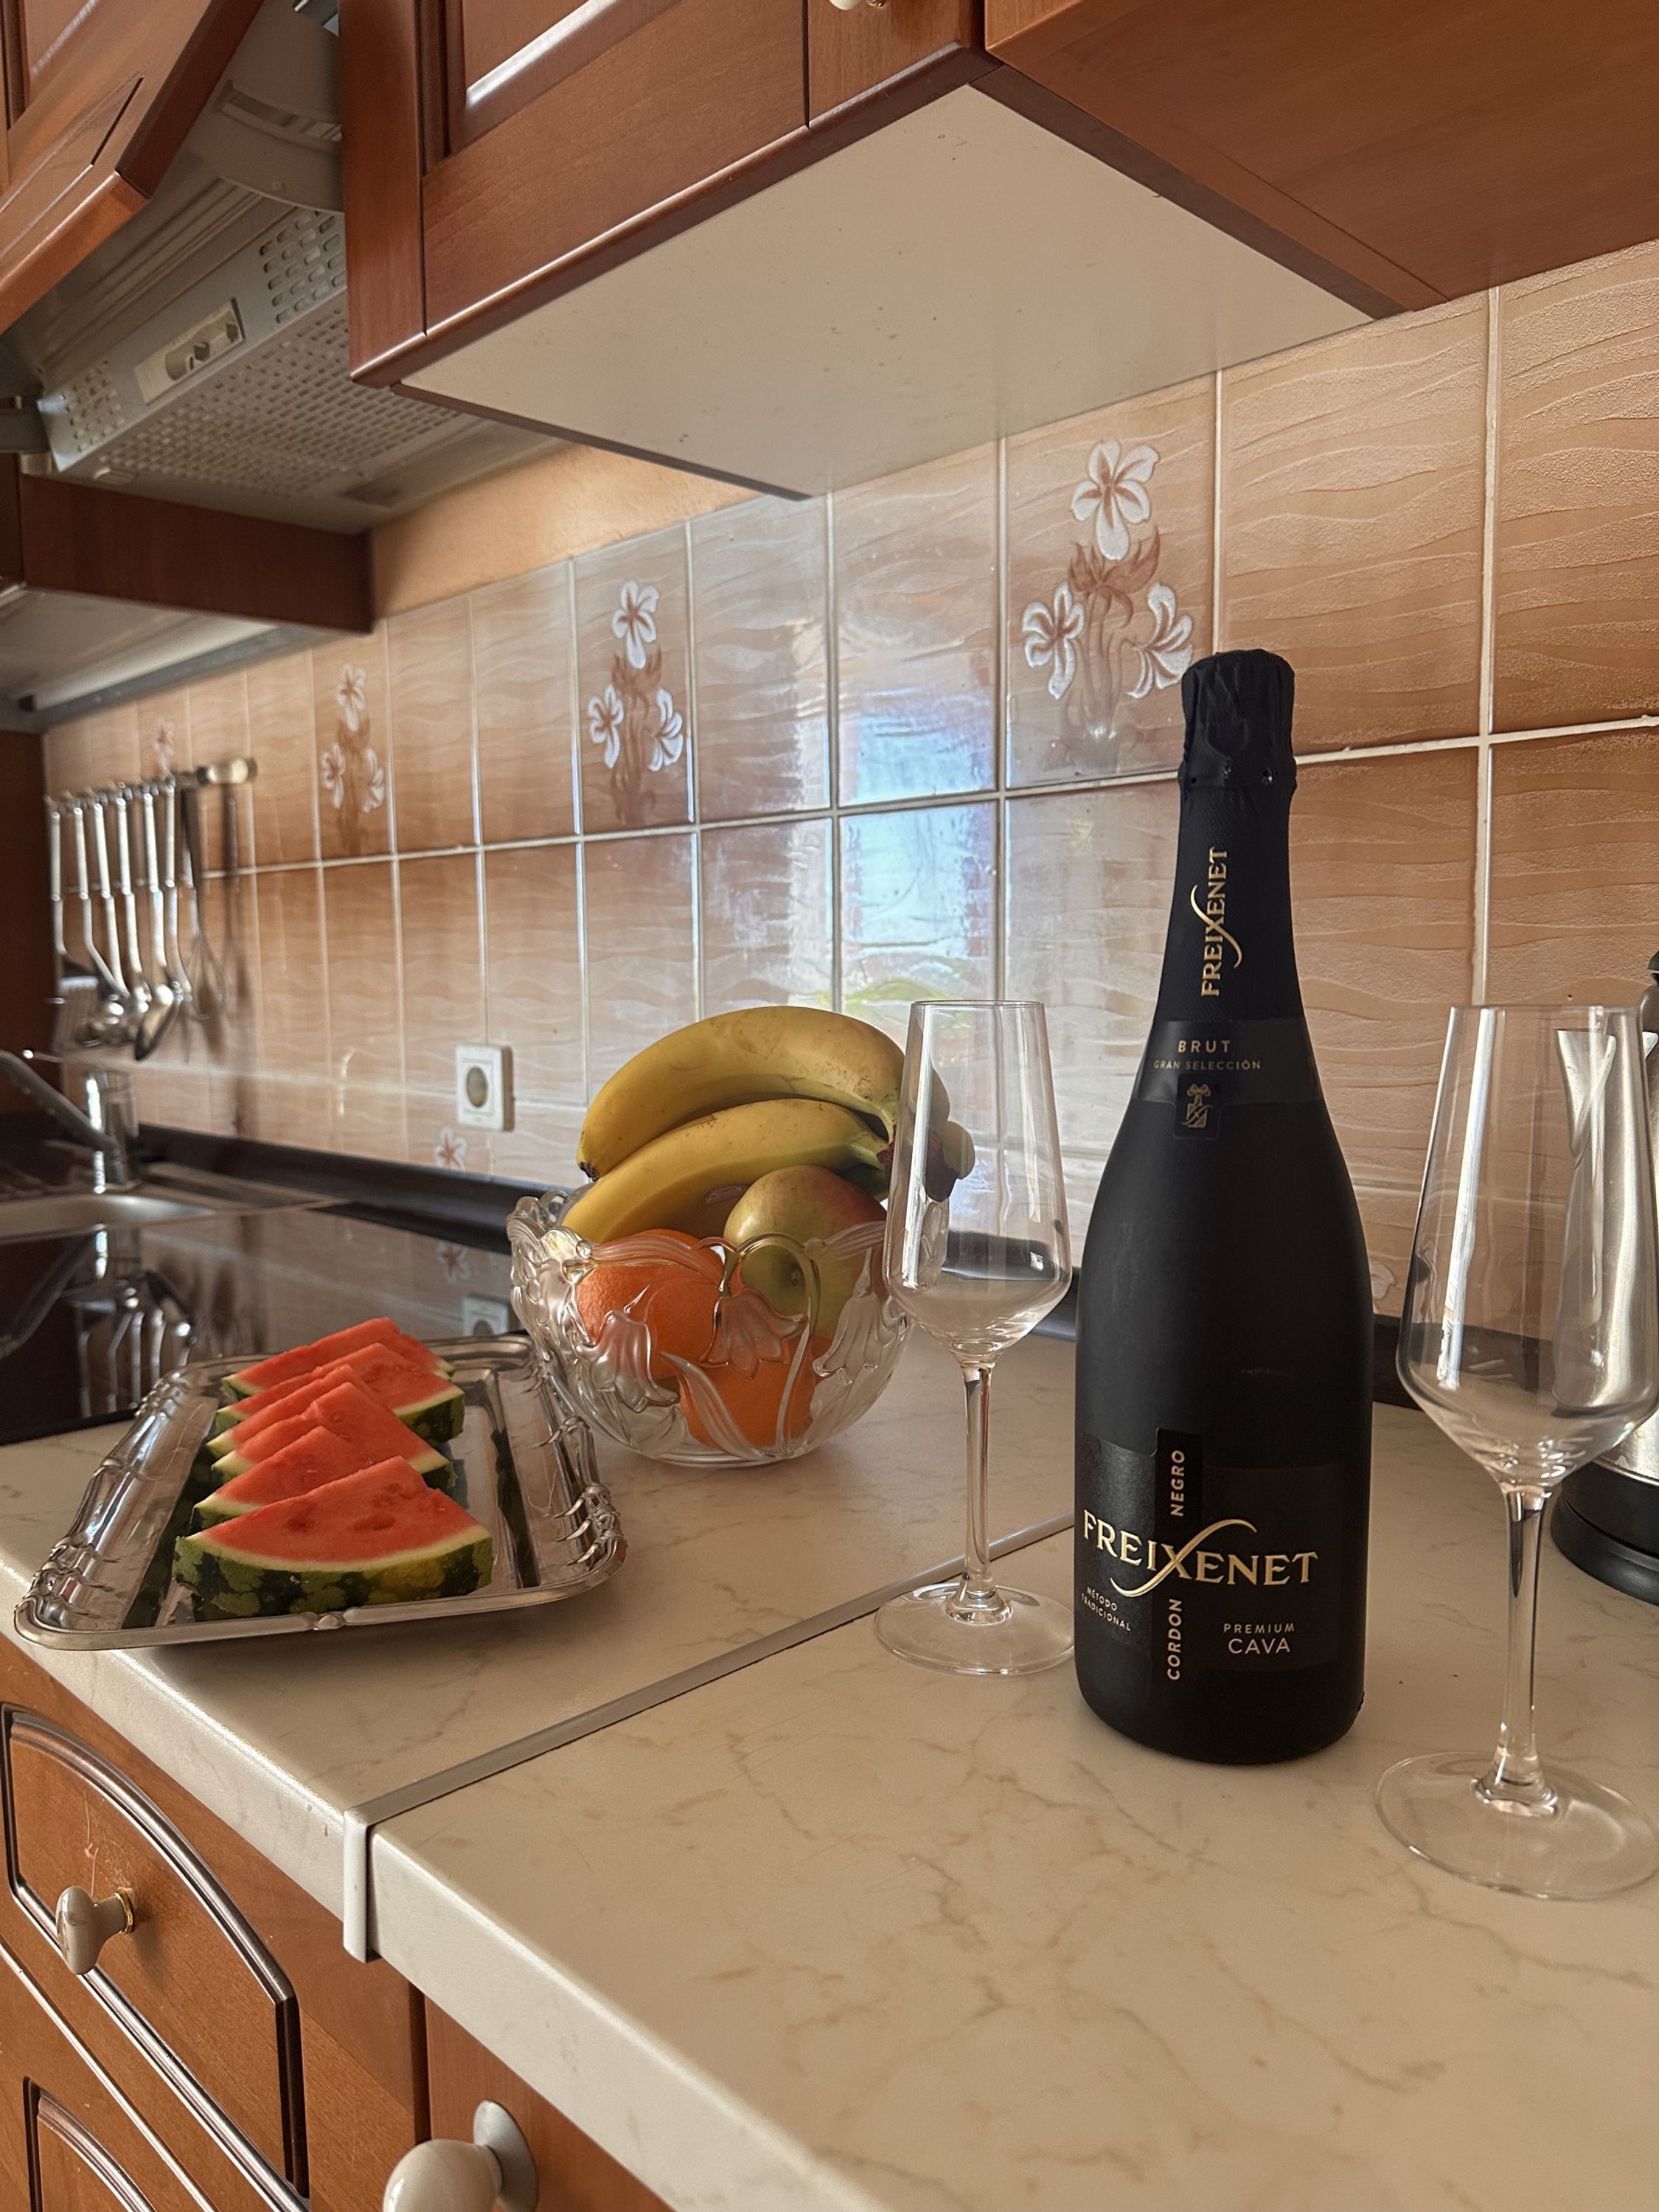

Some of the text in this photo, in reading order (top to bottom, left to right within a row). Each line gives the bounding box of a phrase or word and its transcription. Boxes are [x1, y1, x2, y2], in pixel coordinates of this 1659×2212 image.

[1191, 846, 1243, 997] FREIXENET
[1178, 1040, 1231, 1053] BRUT
[1153, 1060, 1180, 1070] GRAN
[1082, 1509, 1319, 1598] FREIXENET
[1167, 1450, 1186, 1680] CORDON NEGRO
[1081, 1593, 1131, 1631] TRADICIONAL
[1223, 1622, 1295, 1634] PREMIUM
[1228, 1637, 1291, 1655] CAVA
